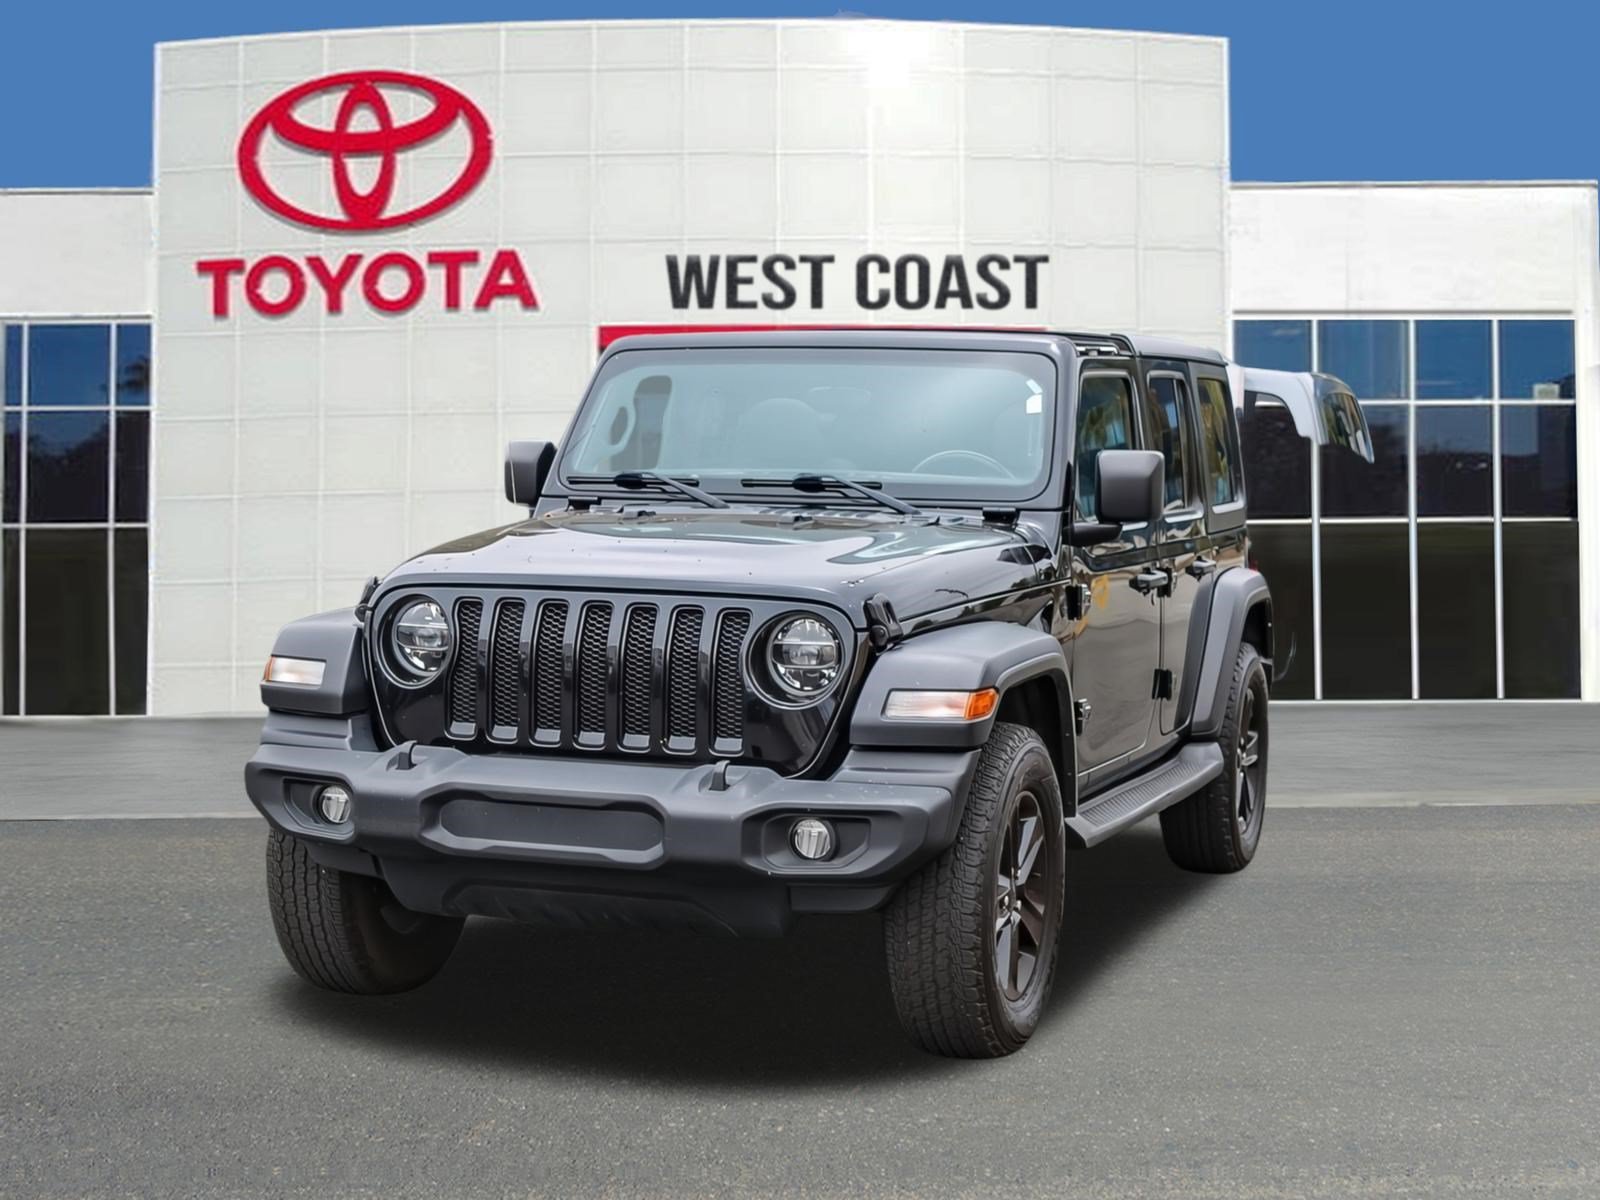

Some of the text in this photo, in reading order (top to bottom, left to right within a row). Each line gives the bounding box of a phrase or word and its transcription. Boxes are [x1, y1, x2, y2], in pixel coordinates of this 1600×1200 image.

[196, 249, 538, 317] TOYOTA
[665, 254, 1049, 310] WEST COAST
